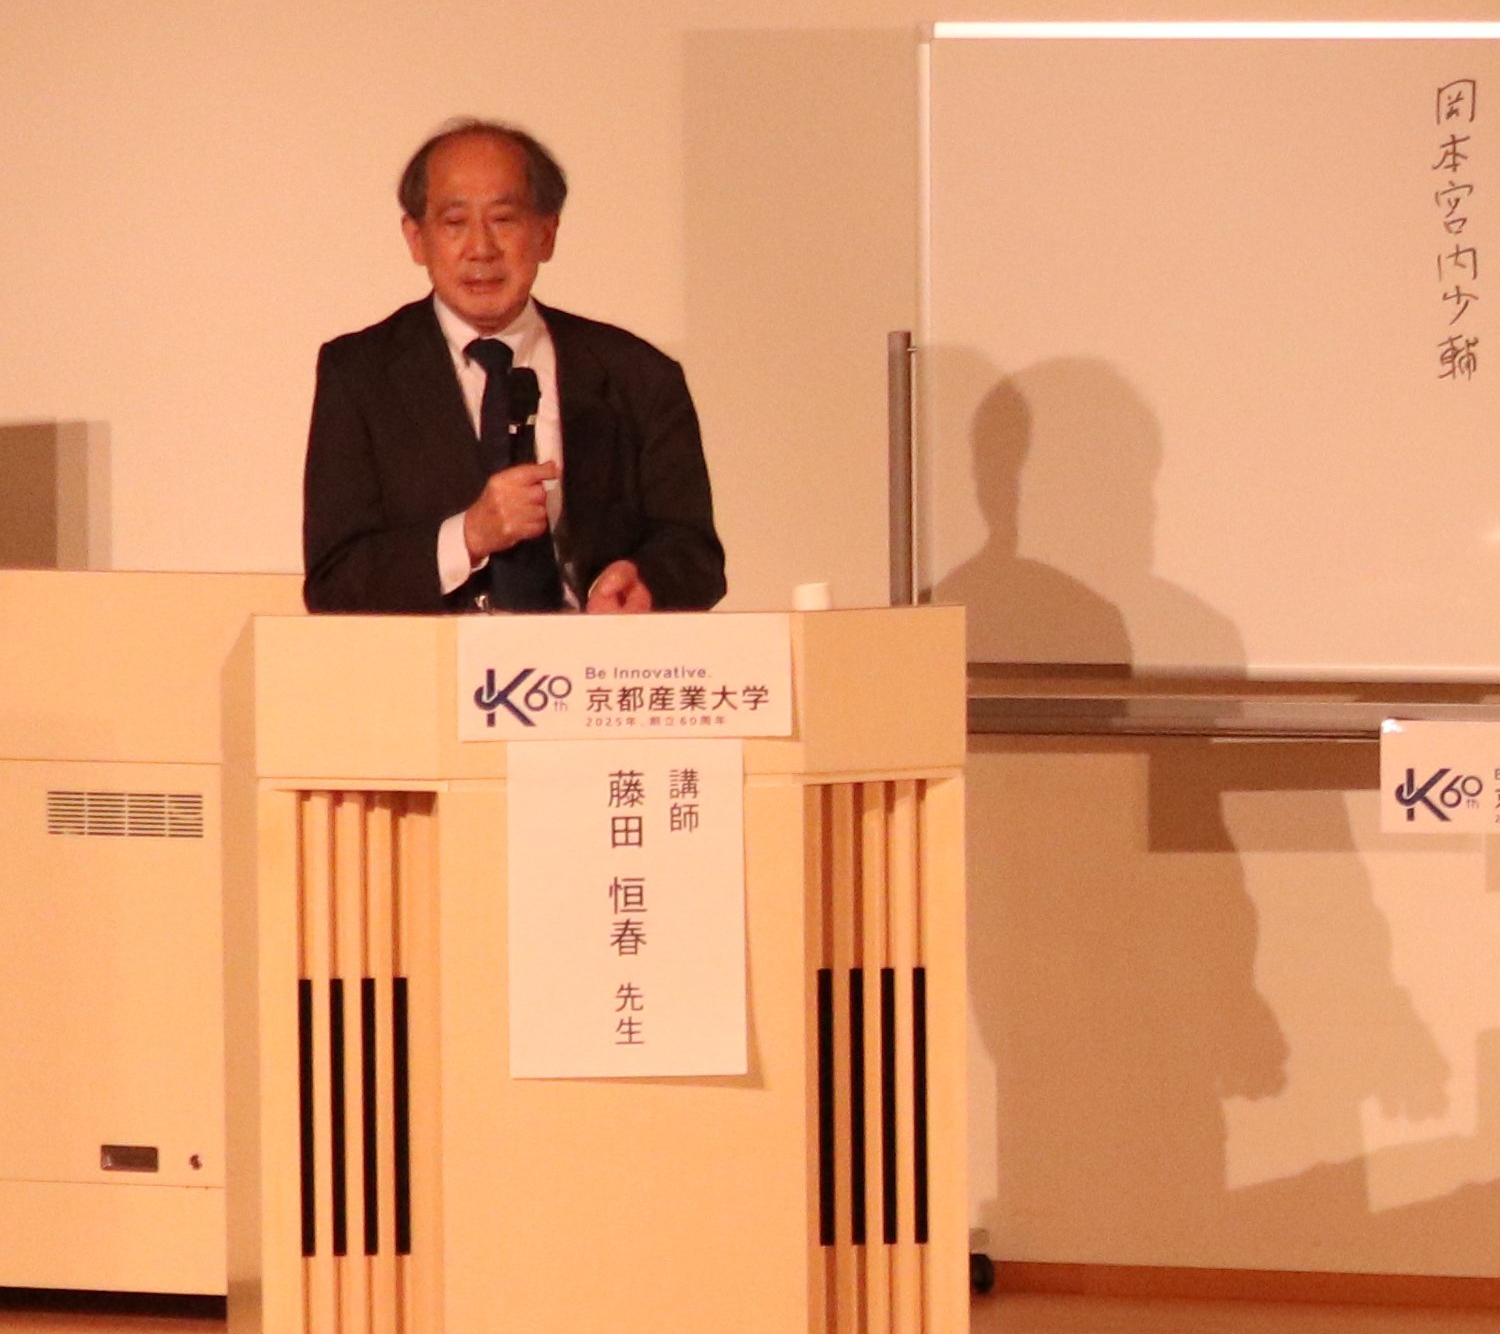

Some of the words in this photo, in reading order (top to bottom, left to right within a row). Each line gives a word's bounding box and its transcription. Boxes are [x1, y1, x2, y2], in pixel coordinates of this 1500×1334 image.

[585, 667, 606, 679] Be
[586, 685, 769, 712] 京都産業大学
[608, 770, 645, 848] 藤田
[669, 768, 699, 833] 講師
[609, 876, 647, 956] 恒春
[615, 982, 644, 1045] 先生
